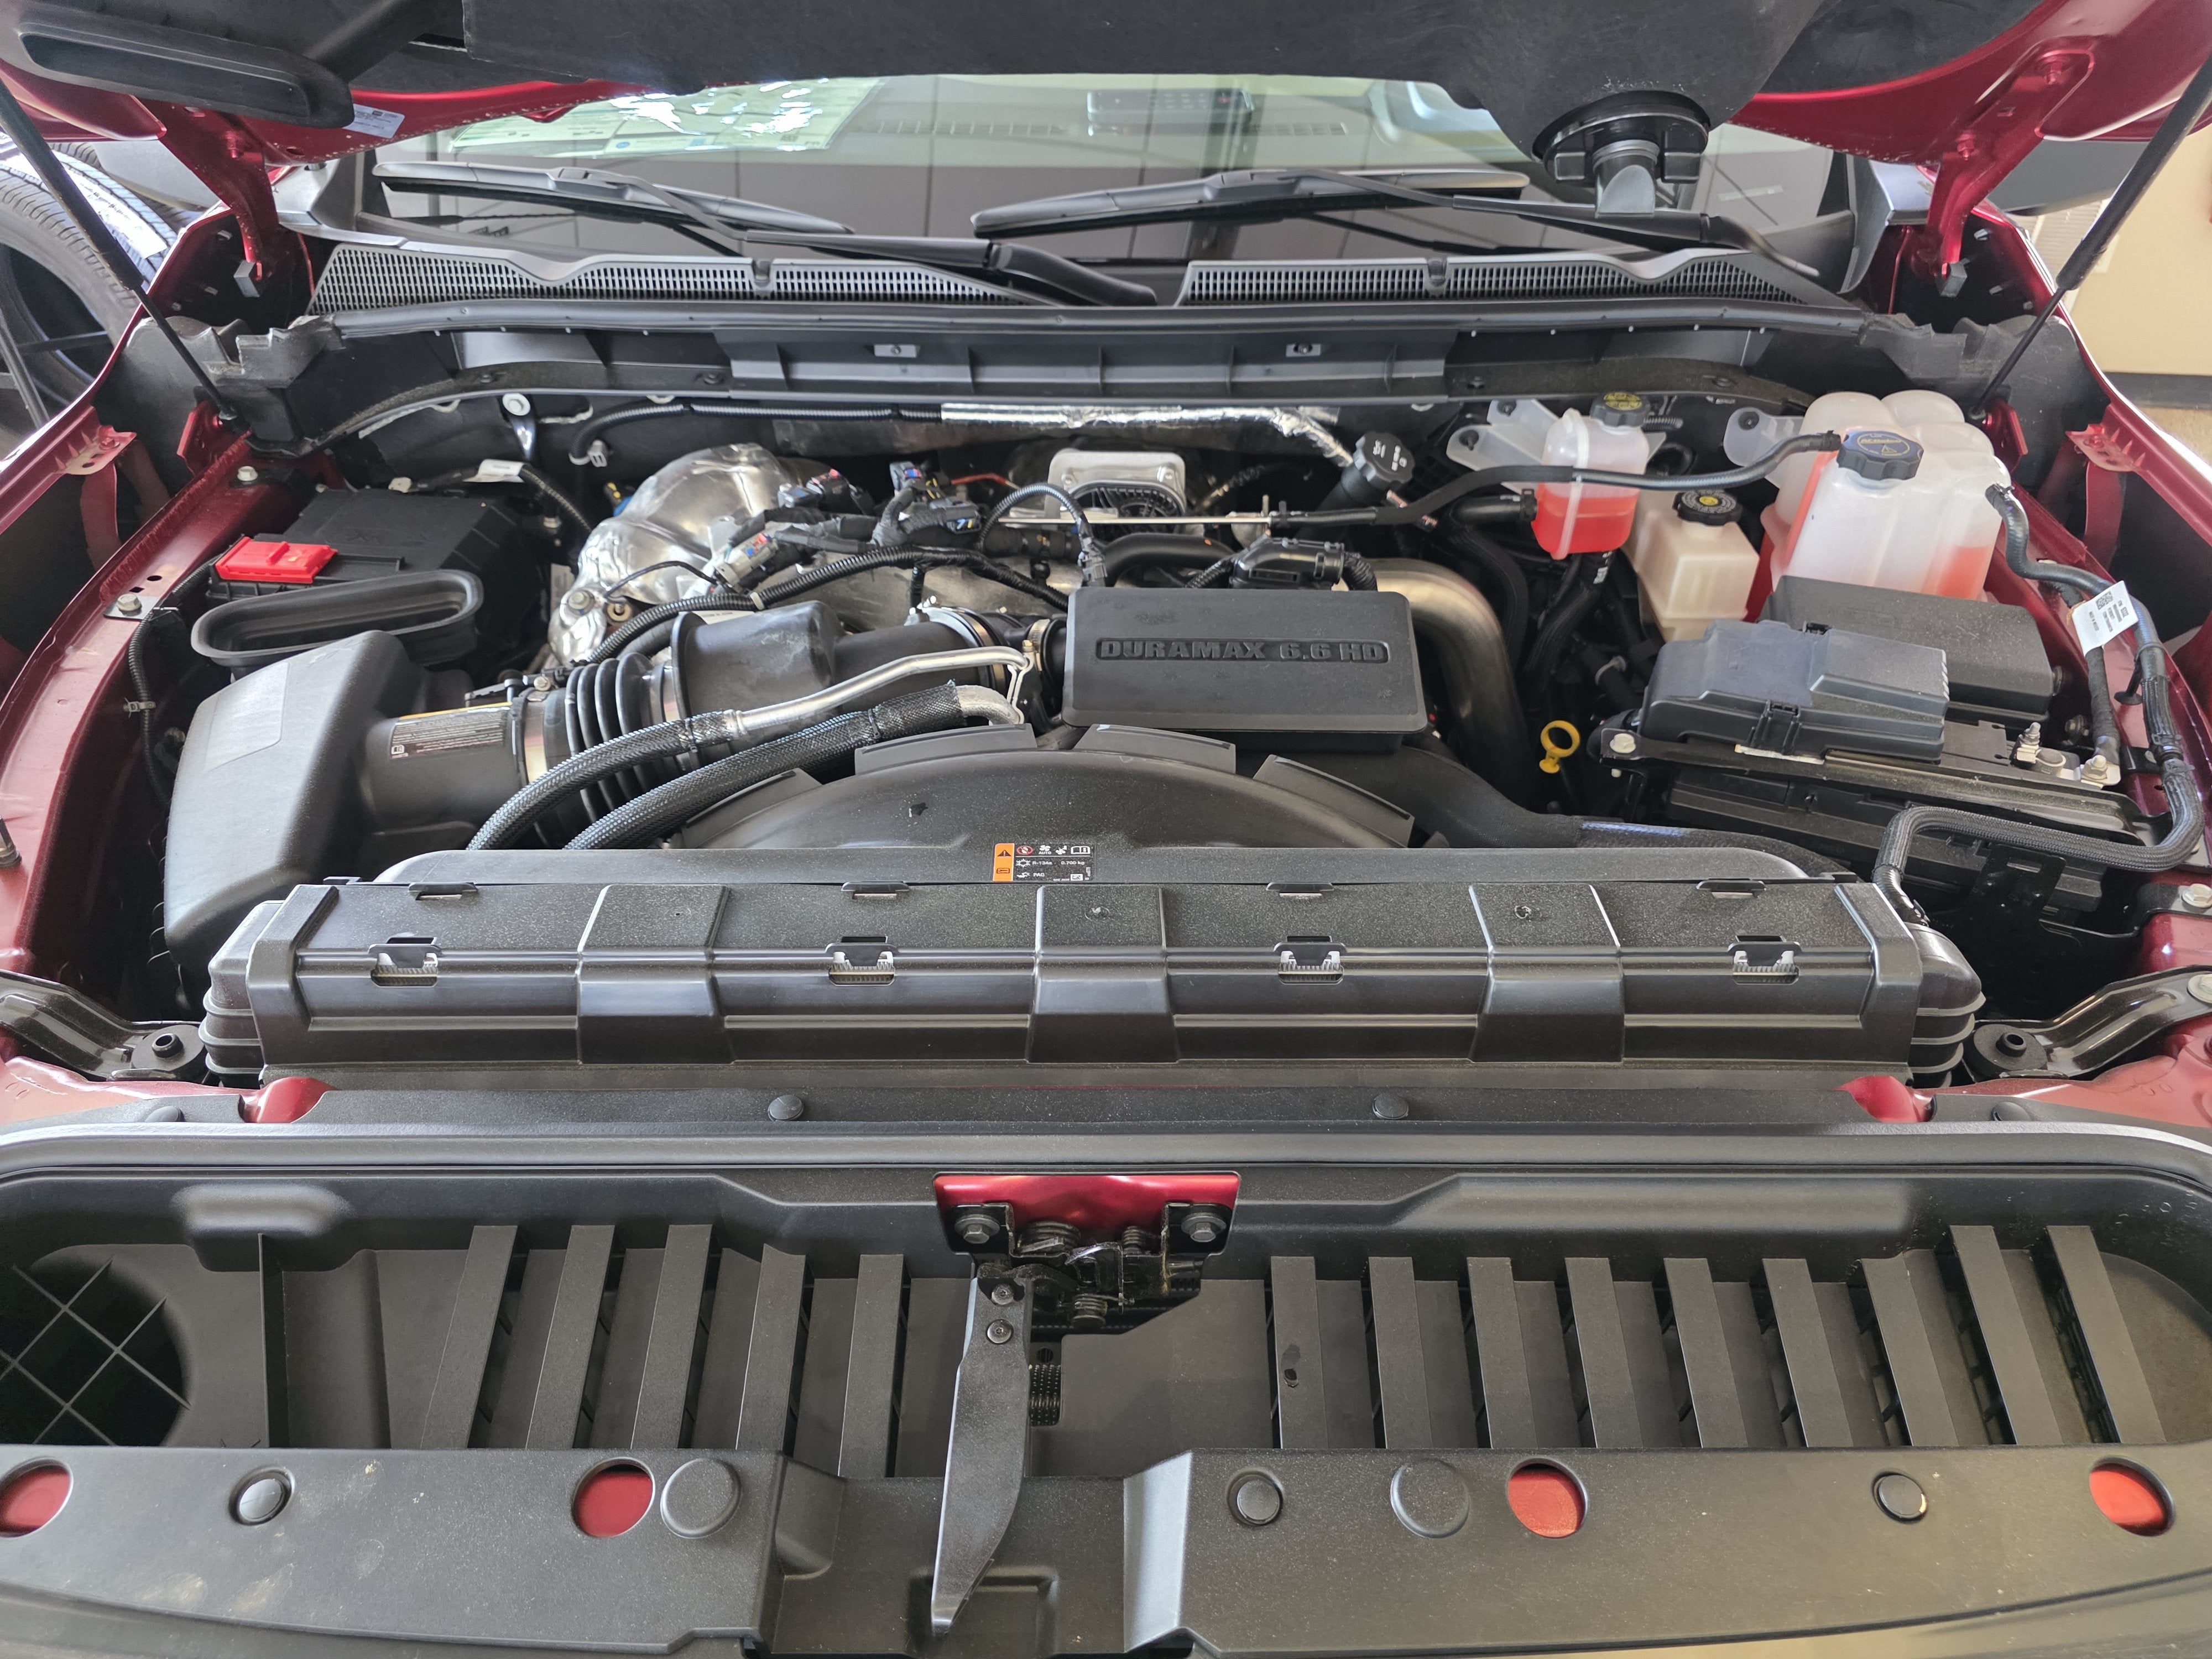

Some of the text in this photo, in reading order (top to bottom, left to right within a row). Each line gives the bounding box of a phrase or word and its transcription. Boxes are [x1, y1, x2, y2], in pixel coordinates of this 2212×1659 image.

[1100, 641, 1385, 661] DURAMAX 6.6 HD
